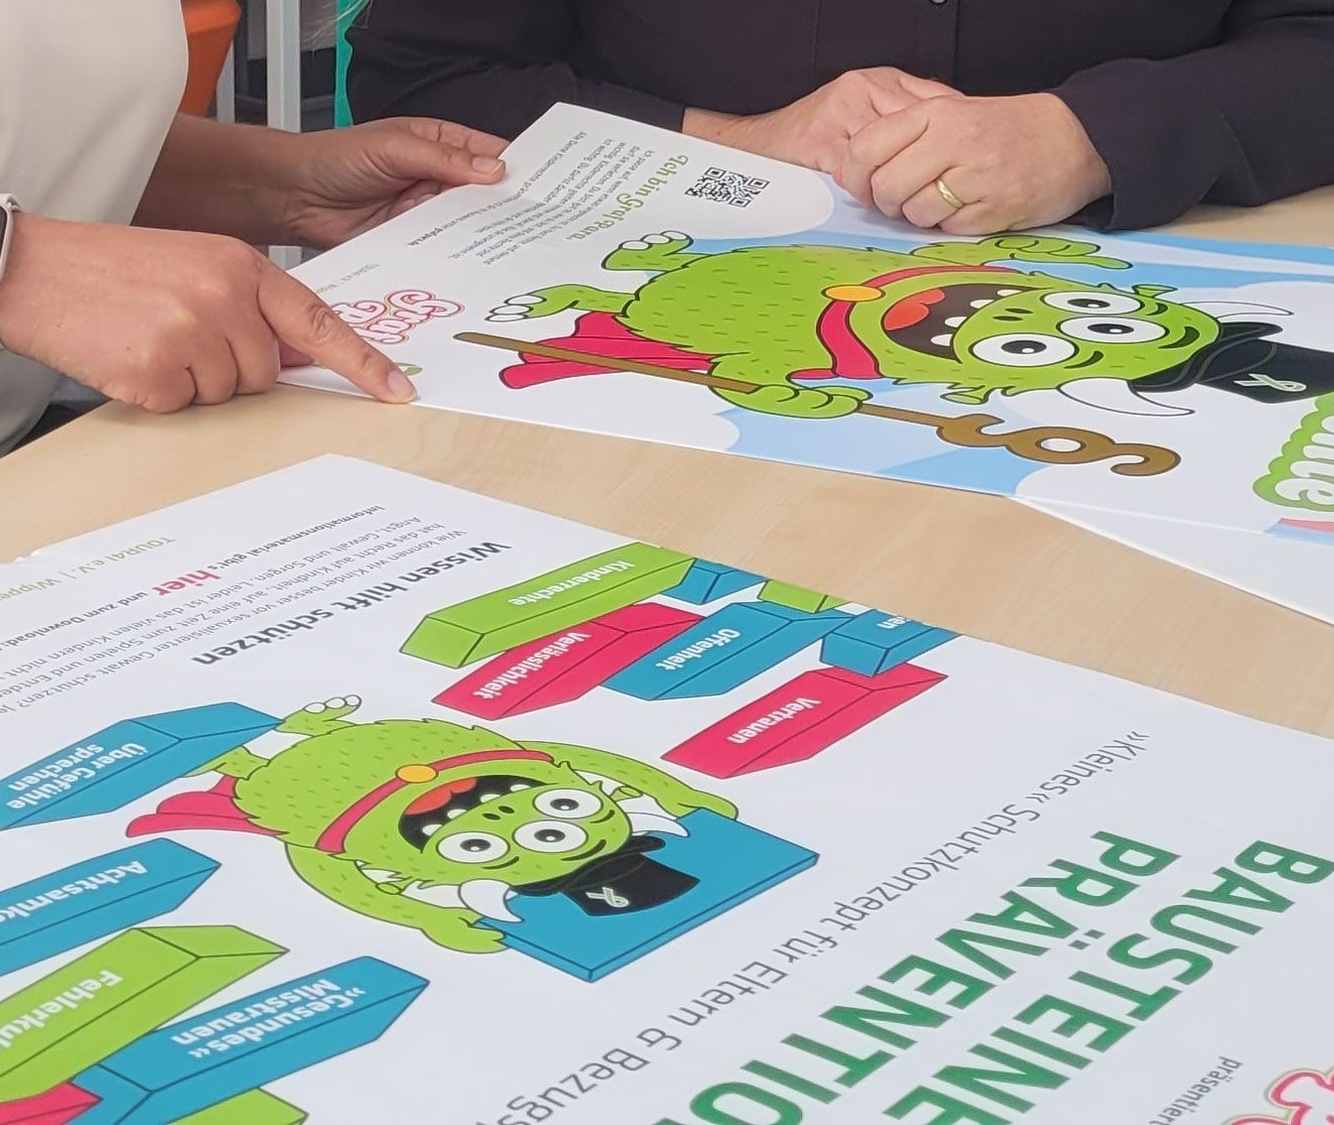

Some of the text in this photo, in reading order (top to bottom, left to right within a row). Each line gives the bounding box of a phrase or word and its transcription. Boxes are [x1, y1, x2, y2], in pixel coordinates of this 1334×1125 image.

[655, 154, 689, 177] Ich
[634, 177, 668, 197] bin
[601, 193, 645, 222] Graf
[565, 219, 615, 240] Para.
[245, 505, 386, 557] Informationsmaterial
[374, 516, 422, 533] Angst,
[416, 522, 446, 534] hat
[392, 531, 419, 543] das
[434, 530, 468, 542] Wie
[302, 549, 332, 564] und
[352, 541, 398, 559] Recht
[386, 540, 440, 561] können
[330, 556, 355, 569] auf
[366, 559, 391, 570] wir
[151, 569, 222, 596] hier
[265, 565, 334, 591] Kindheit,
[320, 567, 370, 588] Kinder
[507, 560, 636, 606] Kinderrechte
[116, 591, 149, 607] und
[206, 581, 255, 601] Leider
[241, 590, 269, 604] auf
[274, 585, 326, 605] besser
[81, 603, 119, 618] zum
[154, 607, 185, 620] das
[182, 598, 210, 609] ist
[191, 541, 512, 665] Wissen hilft schützen
[207, 601, 242, 615] eine
[250, 604, 278, 615] vor
[108, 618, 158, 636] vielen
[174, 612, 213, 627] Zeit
[0, 616, 87, 647] Download:
[140, 625, 178, 640] zum
[152, 613, 252, 653] sexualisierter
[46, 635, 113, 660] Kindern
[82, 638, 144, 663] Spielen
[655, 628, 741, 670] Offenheit
[2, 658, 48, 677] nicht
[49, 661, 84, 677] und
[95, 651, 155, 675] Gewalt
[473, 632, 590, 699] Verlässlichkeit
[16, 673, 97, 708] schützen?
[727, 697, 821, 744] Vertrauen
[6, 743, 149, 809] Über Gefühle
[7, 744, 104, 791] sprechen
[475, 730, 1150, 1125] »Kleines« Schutzkonzept für Eltern & Bezugs
[652, 830, 1182, 1125] PRÄVENTIO
[171, 978, 342, 1045] Misstrauen
[188, 987, 366, 1058] »Gesundes«
